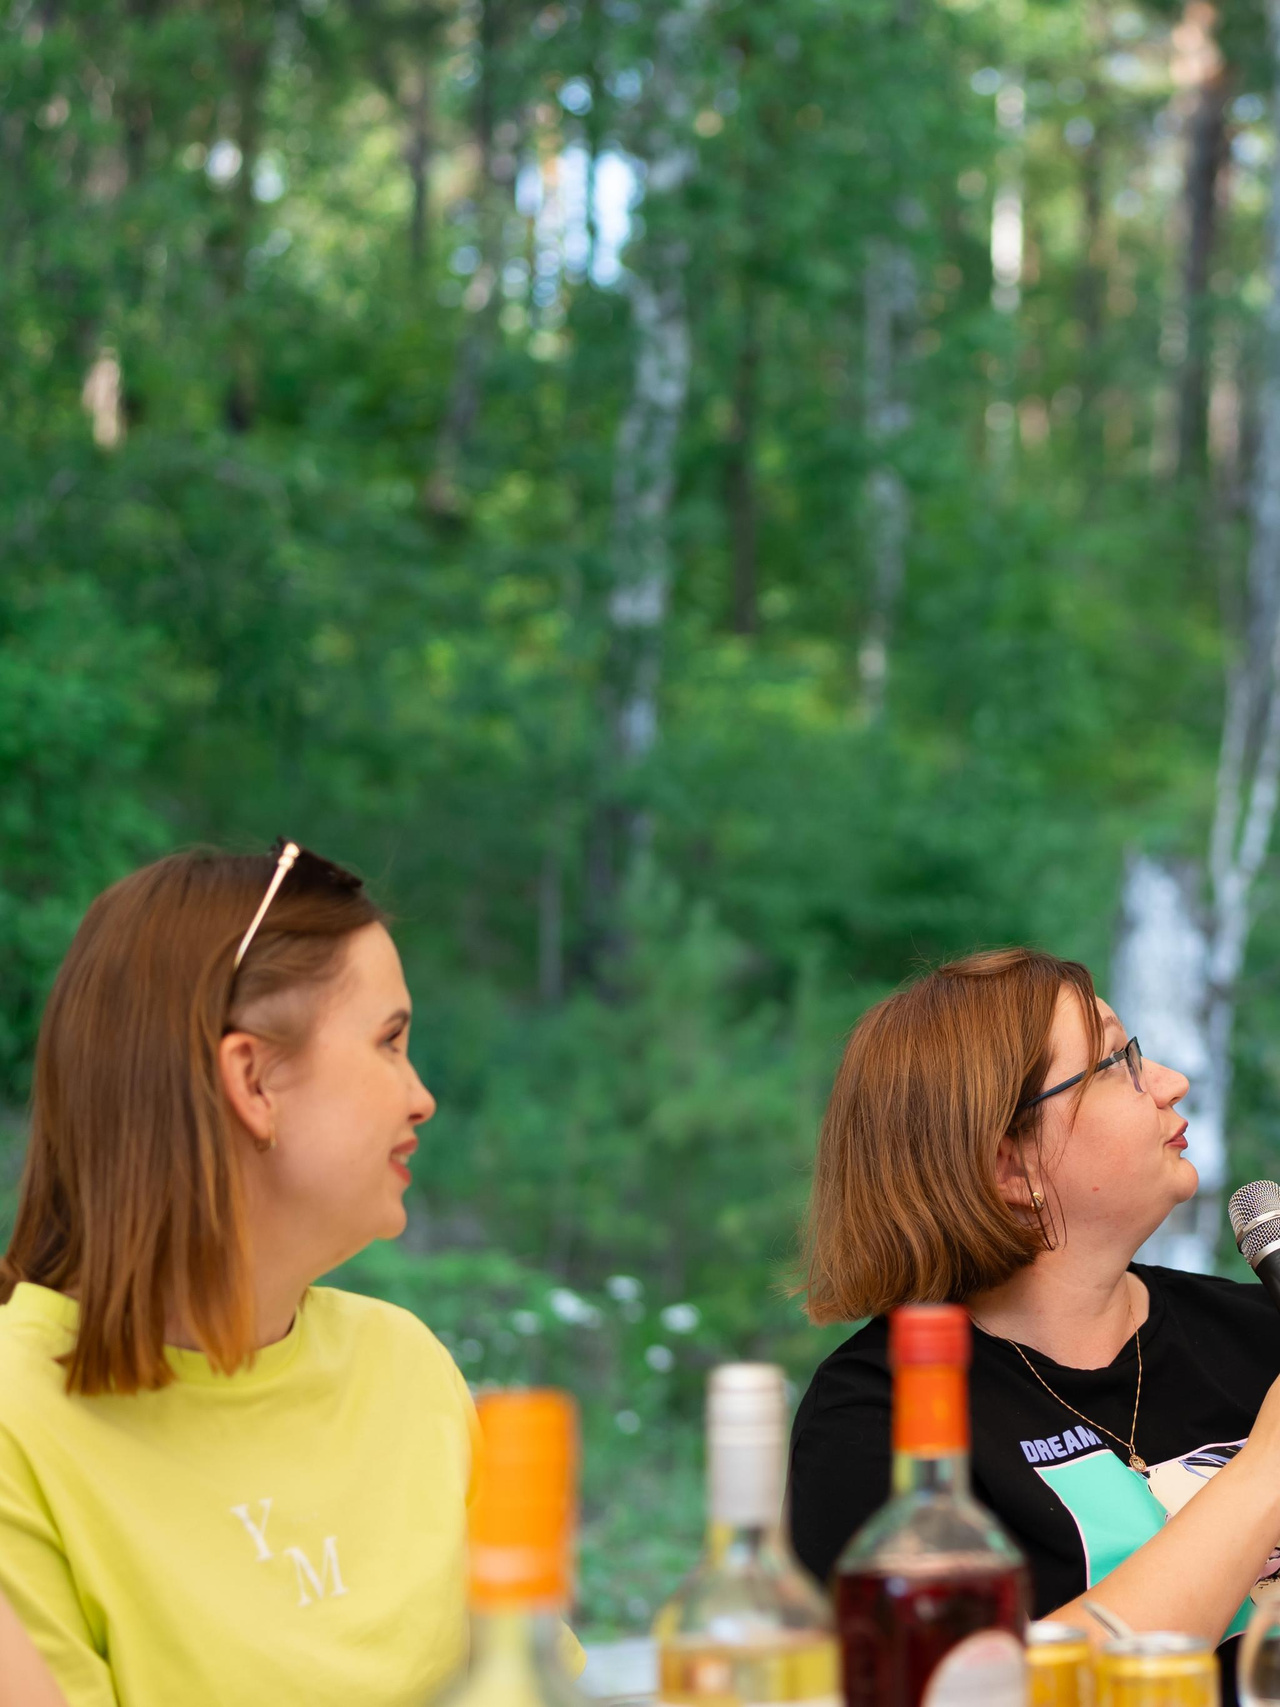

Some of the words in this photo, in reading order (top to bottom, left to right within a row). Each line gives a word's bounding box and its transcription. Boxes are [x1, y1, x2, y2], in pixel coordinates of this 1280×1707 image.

[1020, 1425, 1109, 1463] DREAM
[229, 1497, 274, 1562] Y
[283, 1535, 350, 1607] M
